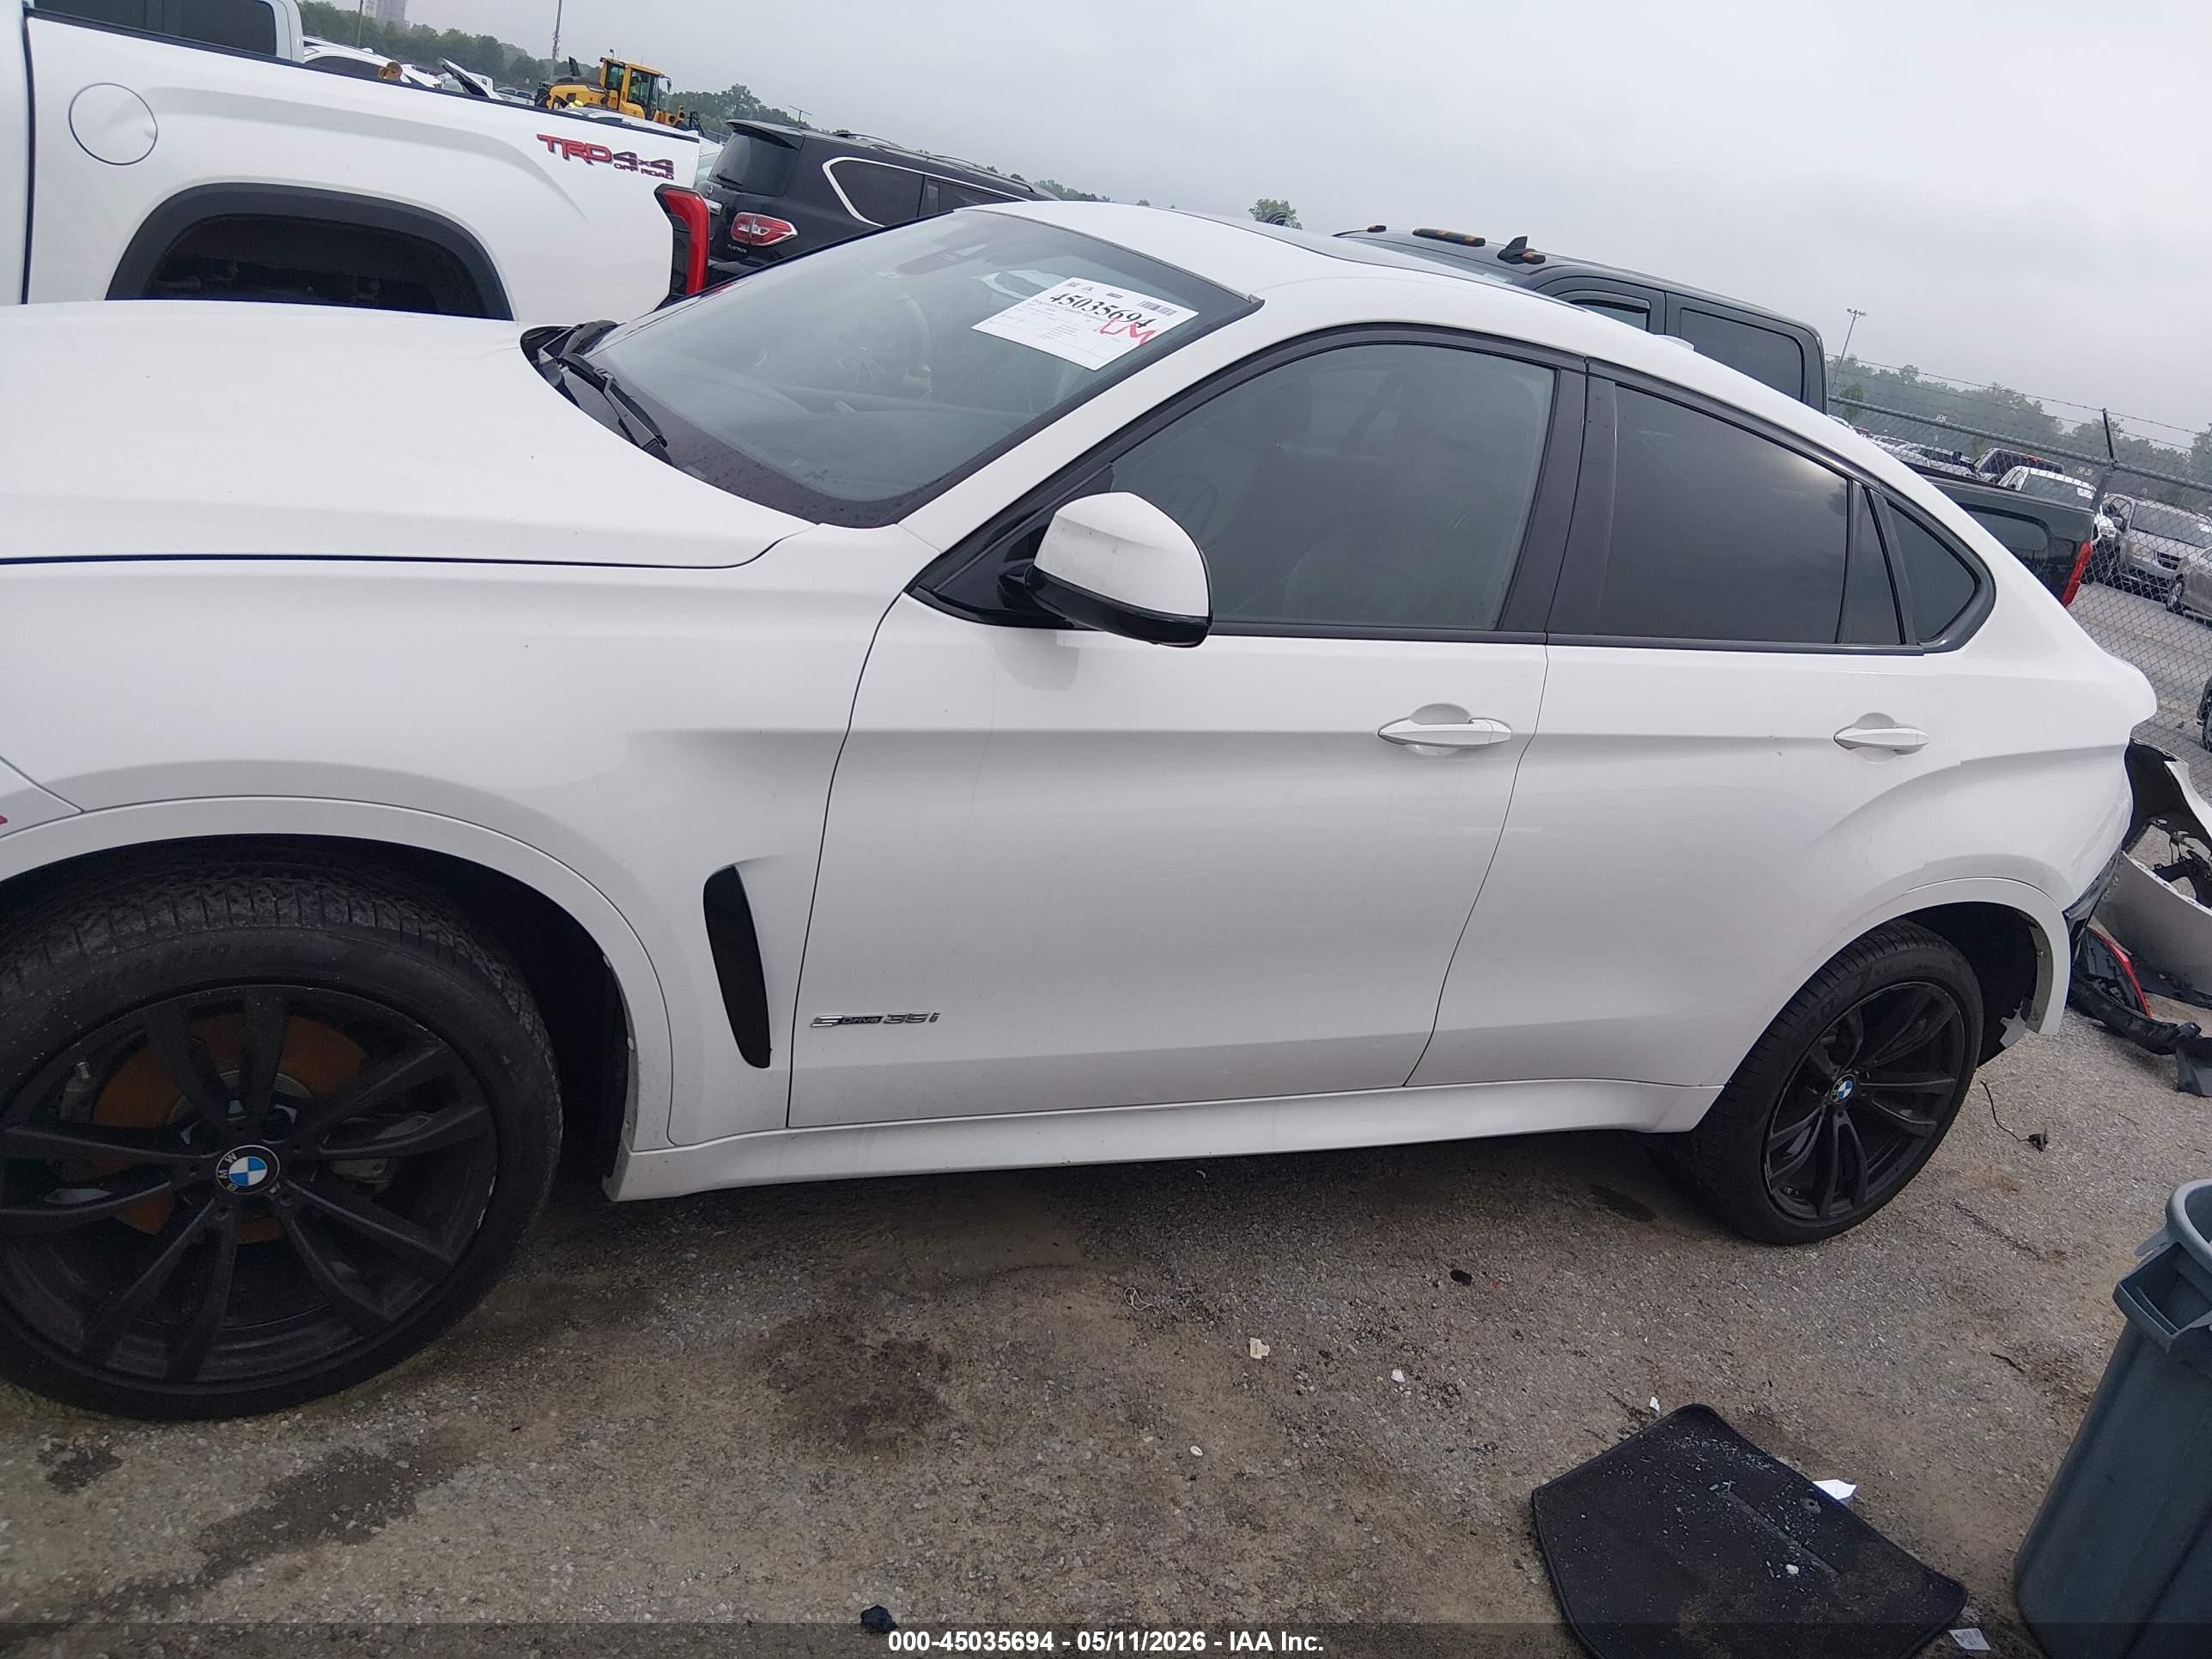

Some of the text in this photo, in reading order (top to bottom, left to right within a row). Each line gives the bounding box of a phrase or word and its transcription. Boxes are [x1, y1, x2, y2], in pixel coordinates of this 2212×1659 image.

[537, 133, 613, 166] TRD
[613, 162, 675, 180] OFF ROAD
[1049, 293, 1158, 329] 45035694
